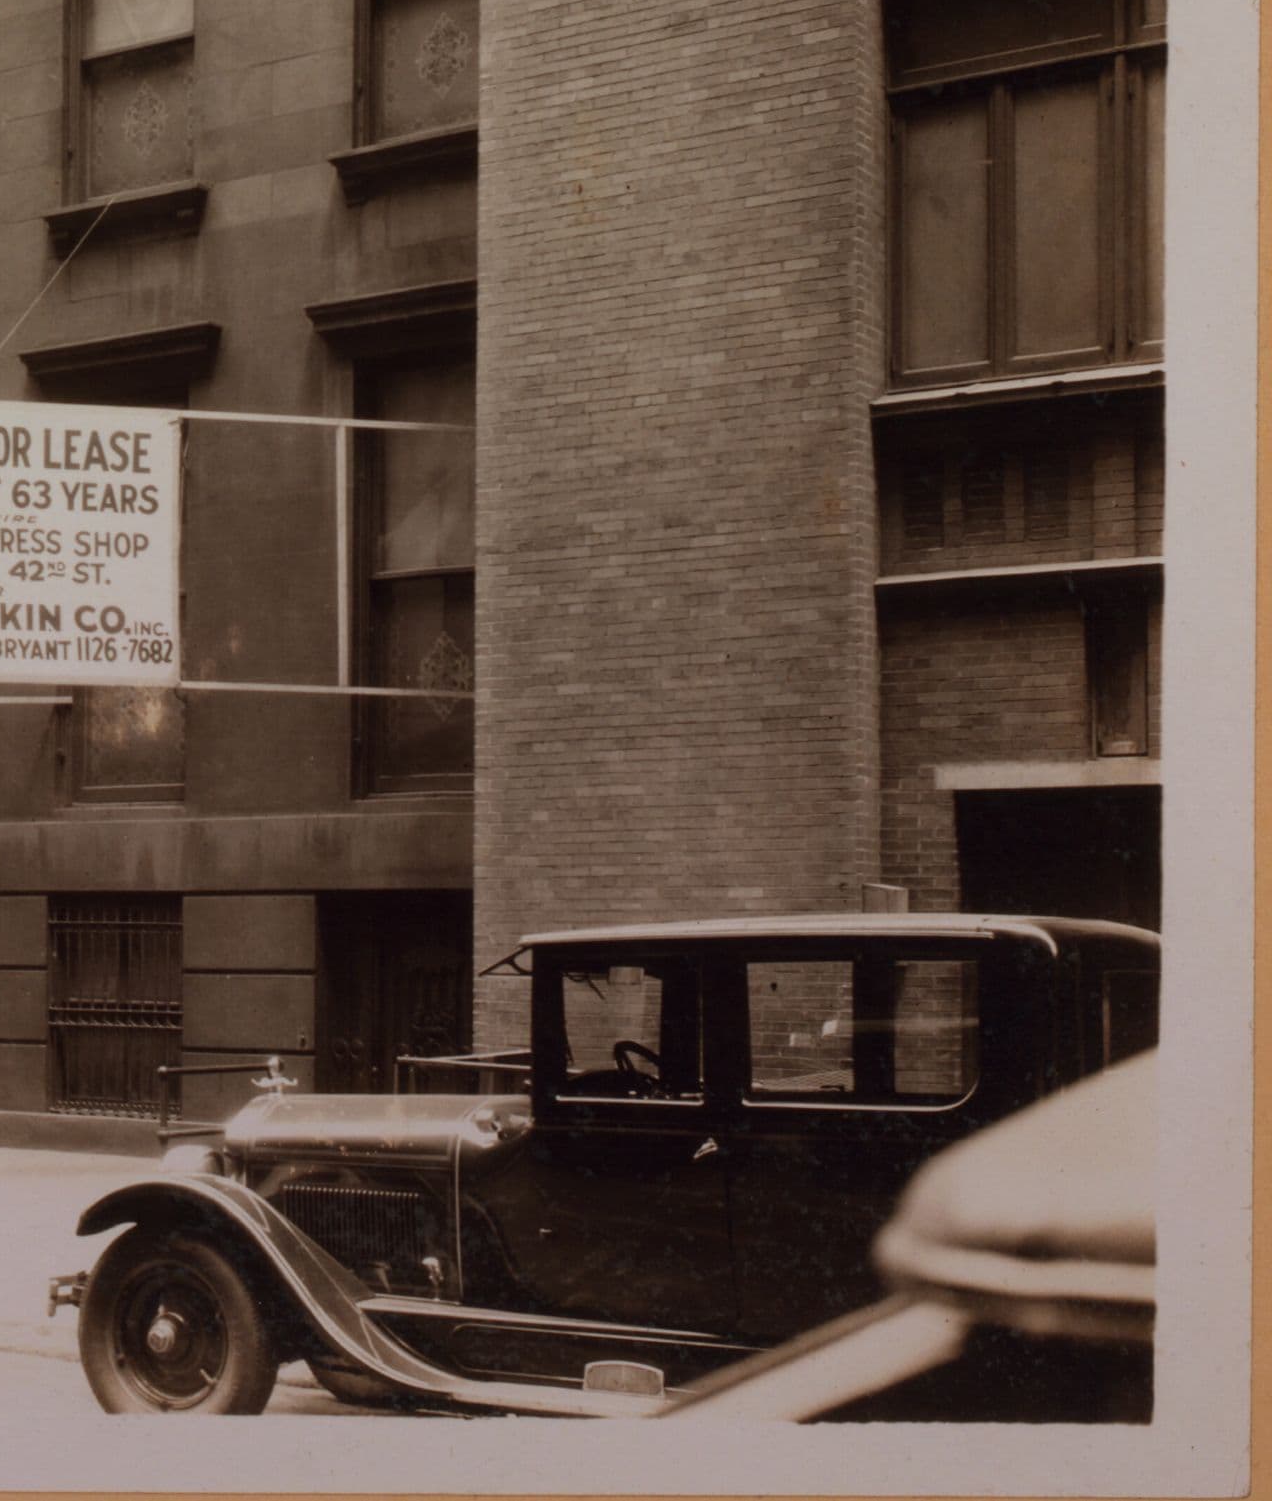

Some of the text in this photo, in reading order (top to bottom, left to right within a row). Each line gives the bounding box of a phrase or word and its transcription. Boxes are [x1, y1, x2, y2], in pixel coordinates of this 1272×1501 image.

[44, 429, 151, 473] LEASE
[11, 481, 51, 510] 63
[62, 481, 159, 515] YEARS
[74, 531, 149, 558] SHOP
[72, 563, 112, 585] ST.
[74, 605, 131, 634] CO.
[133, 621, 169, 637] INC.
